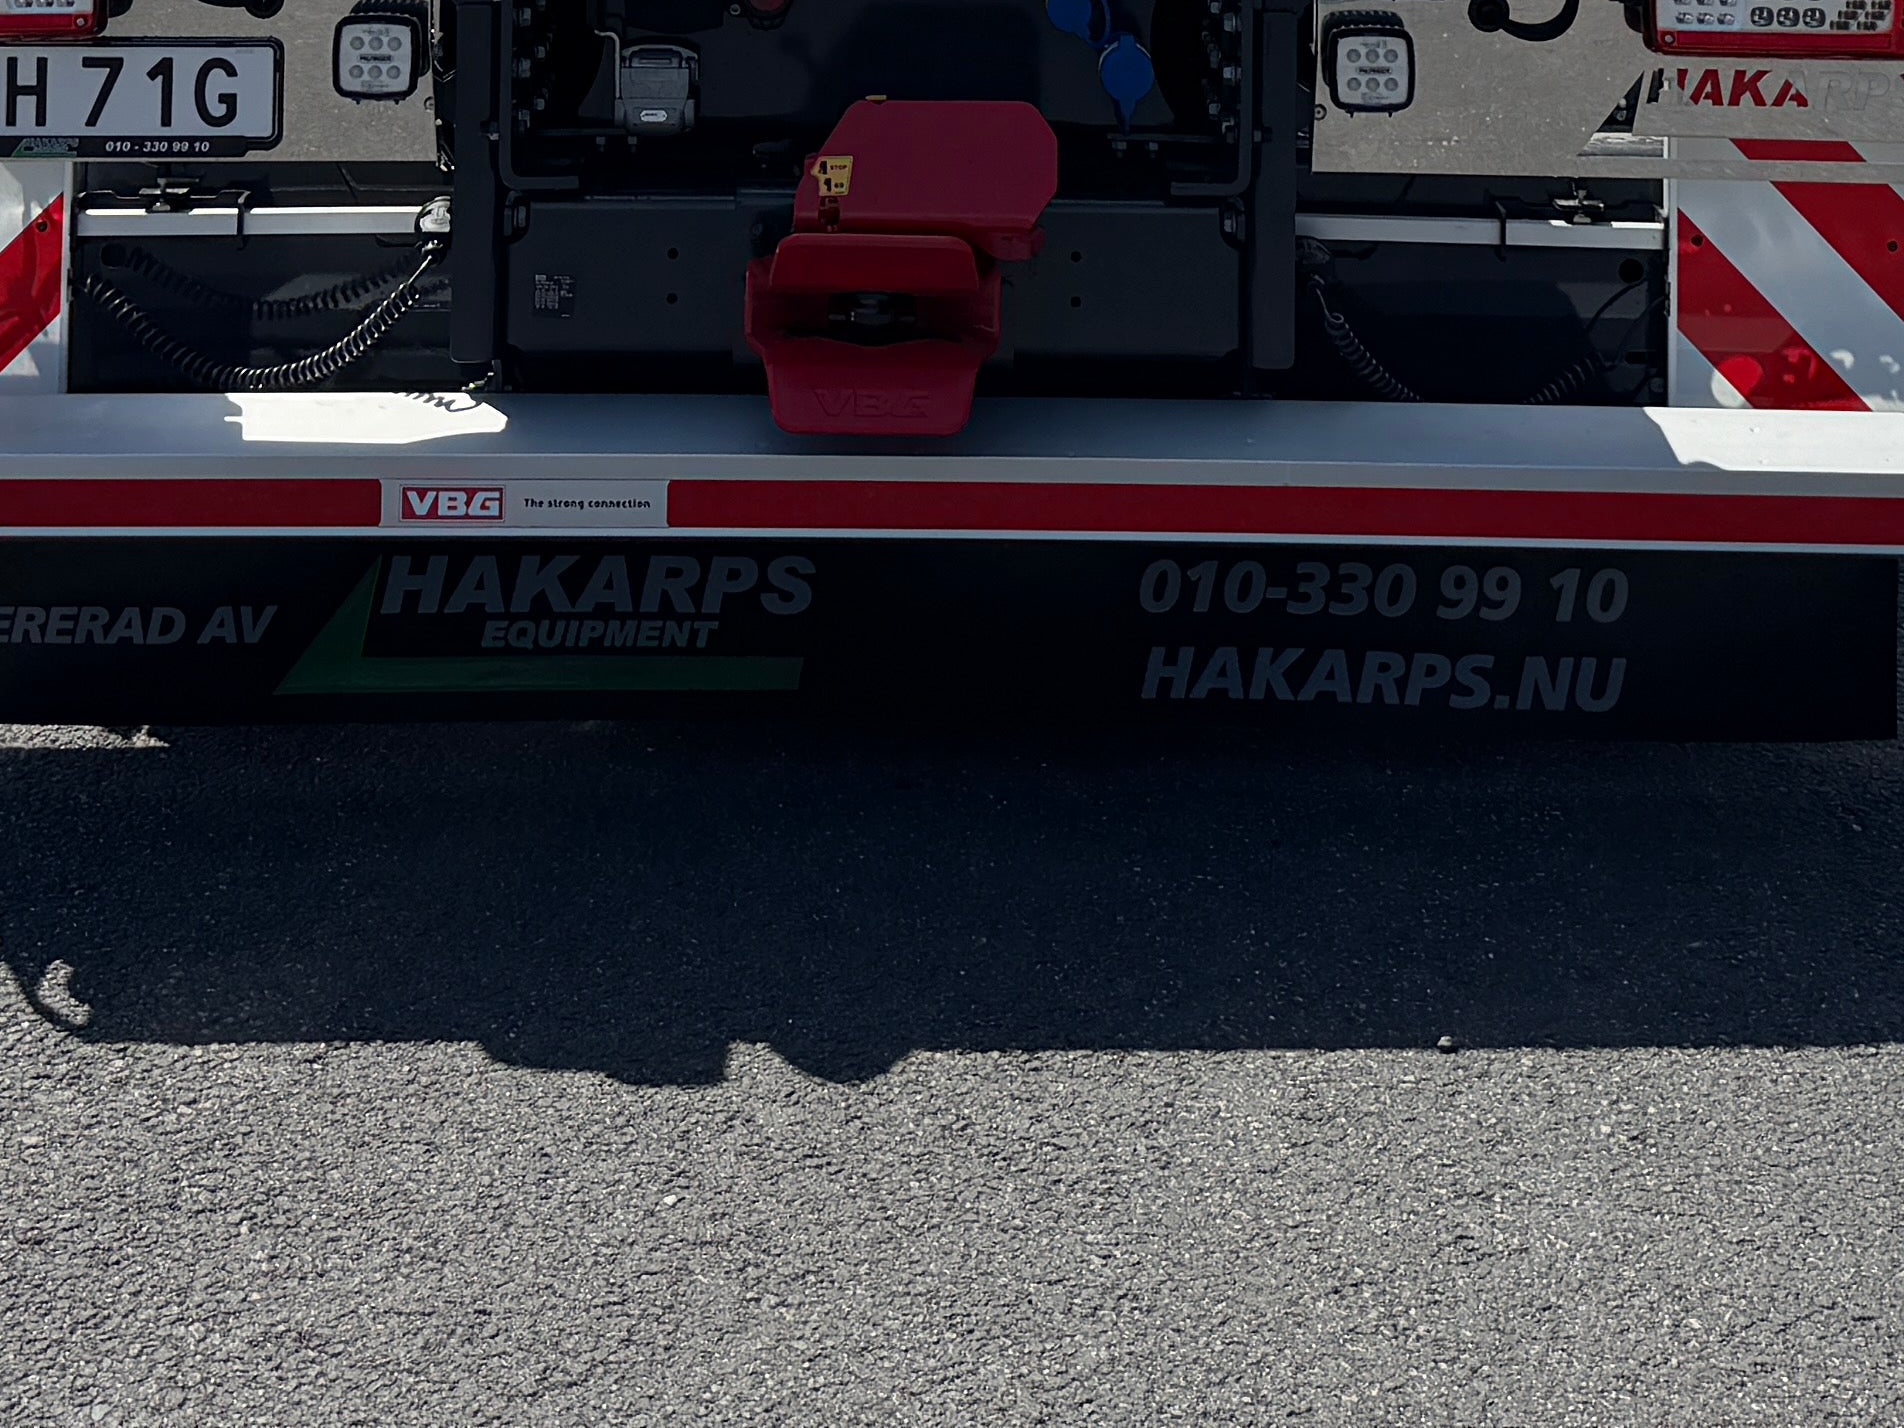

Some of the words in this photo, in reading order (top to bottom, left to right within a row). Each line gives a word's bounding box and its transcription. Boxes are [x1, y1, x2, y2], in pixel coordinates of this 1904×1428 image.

[82, 56, 238, 128] 71G
[105, 141, 132, 152] 010
[143, 141, 169, 153] 330
[194, 141, 210, 152] 10
[406, 491, 500, 517] VBG
[524, 498, 544, 508] The
[548, 498, 584, 510] strong
[588, 498, 651, 509] connection
[379, 553, 817, 617] HAKARPS
[1138, 559, 1419, 619] 010-330
[1435, 564, 1543, 622] 99
[1549, 566, 1630, 624] 10
[196, 604, 279, 644] AV
[480, 618, 720, 650] EQUIPMENT
[1140, 646, 1628, 713] HAKARPS.NU
